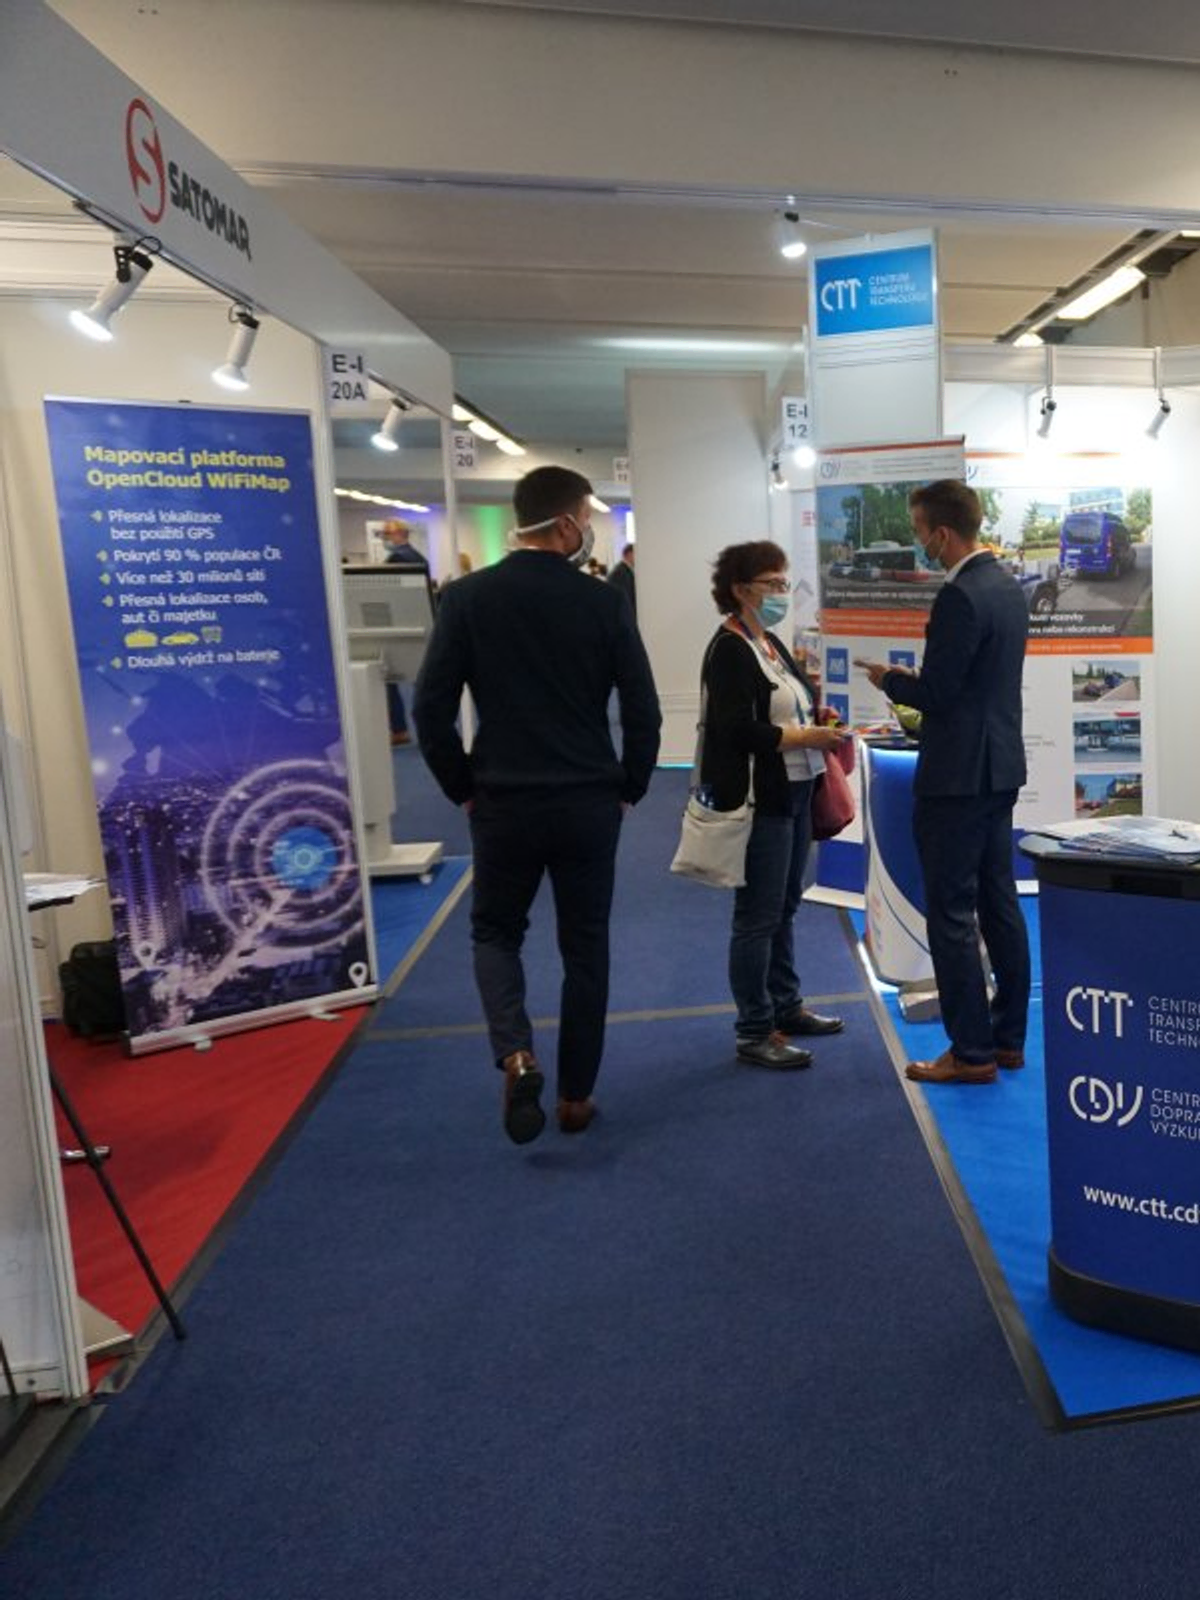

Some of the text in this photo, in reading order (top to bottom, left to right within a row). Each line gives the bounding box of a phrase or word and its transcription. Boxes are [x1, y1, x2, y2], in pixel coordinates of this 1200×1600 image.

[168, 160, 252, 261] SATOMAR
[820, 277, 862, 312] CTT
[332, 354, 363, 374] E-I
[331, 381, 366, 400] 20A
[787, 403, 808, 418] E-I
[788, 424, 808, 438] 12
[84, 446, 286, 468] Mapovací platforma
[86, 470, 290, 492] OpenCloud WiFiMap
[108, 508, 223, 524] Přesná lokalizace
[111, 527, 136, 540] bez
[187, 528, 215, 540] GPS
[164, 550, 181, 562] 90
[185, 550, 200, 562] %
[204, 550, 261, 563] populace
[116, 571, 146, 585] Více
[150, 570, 174, 584] než
[177, 571, 194, 583] 30
[119, 593, 166, 607] Přesná
[170, 592, 231, 605] lokalizace
[122, 612, 145, 624] aut
[164, 609, 216, 624] majetku
[128, 654, 175, 668] Dlouhá
[218, 653, 234, 663] na
[1066, 985, 1134, 1038] CTT
[1069, 1075, 1143, 1127] CDV
